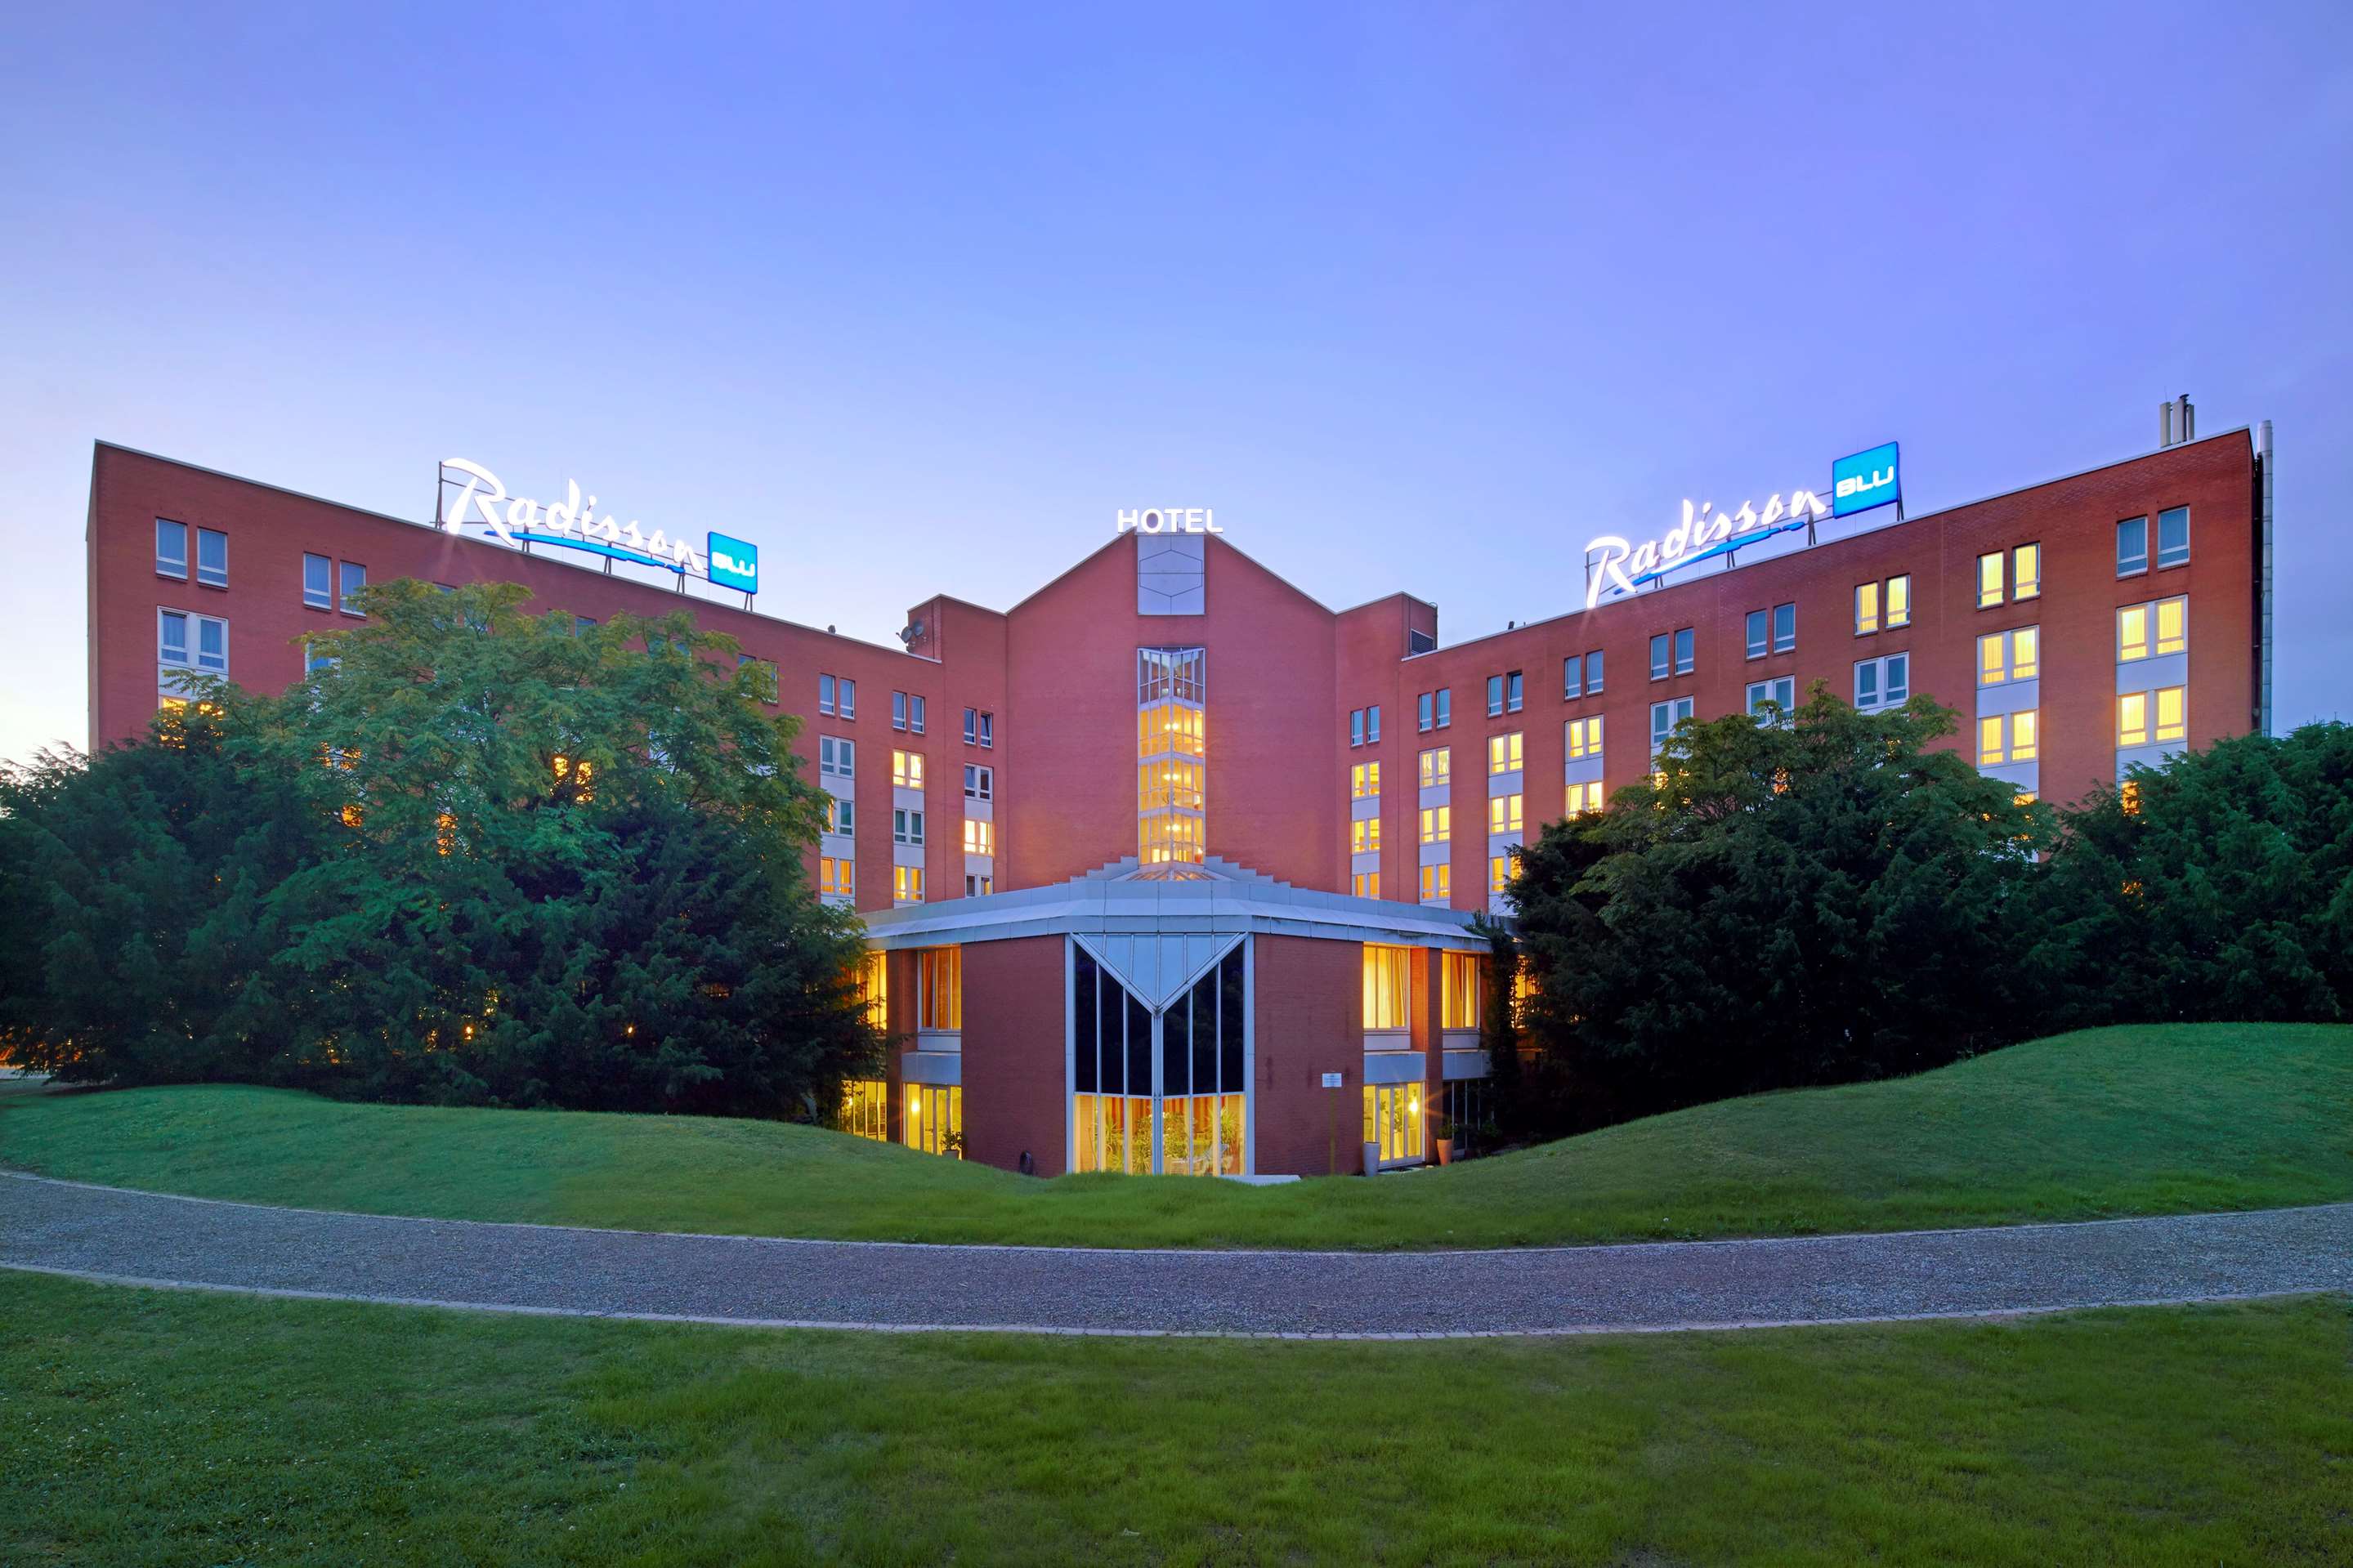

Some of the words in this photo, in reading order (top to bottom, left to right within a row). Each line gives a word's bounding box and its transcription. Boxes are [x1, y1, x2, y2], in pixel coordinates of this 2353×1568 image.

[442, 458, 704, 572] Radisson
[711, 551, 755, 578] BLU
[1117, 508, 1223, 533] HOTEL
[1585, 490, 1827, 609] Radisson
[1836, 466, 1894, 498] BLU
